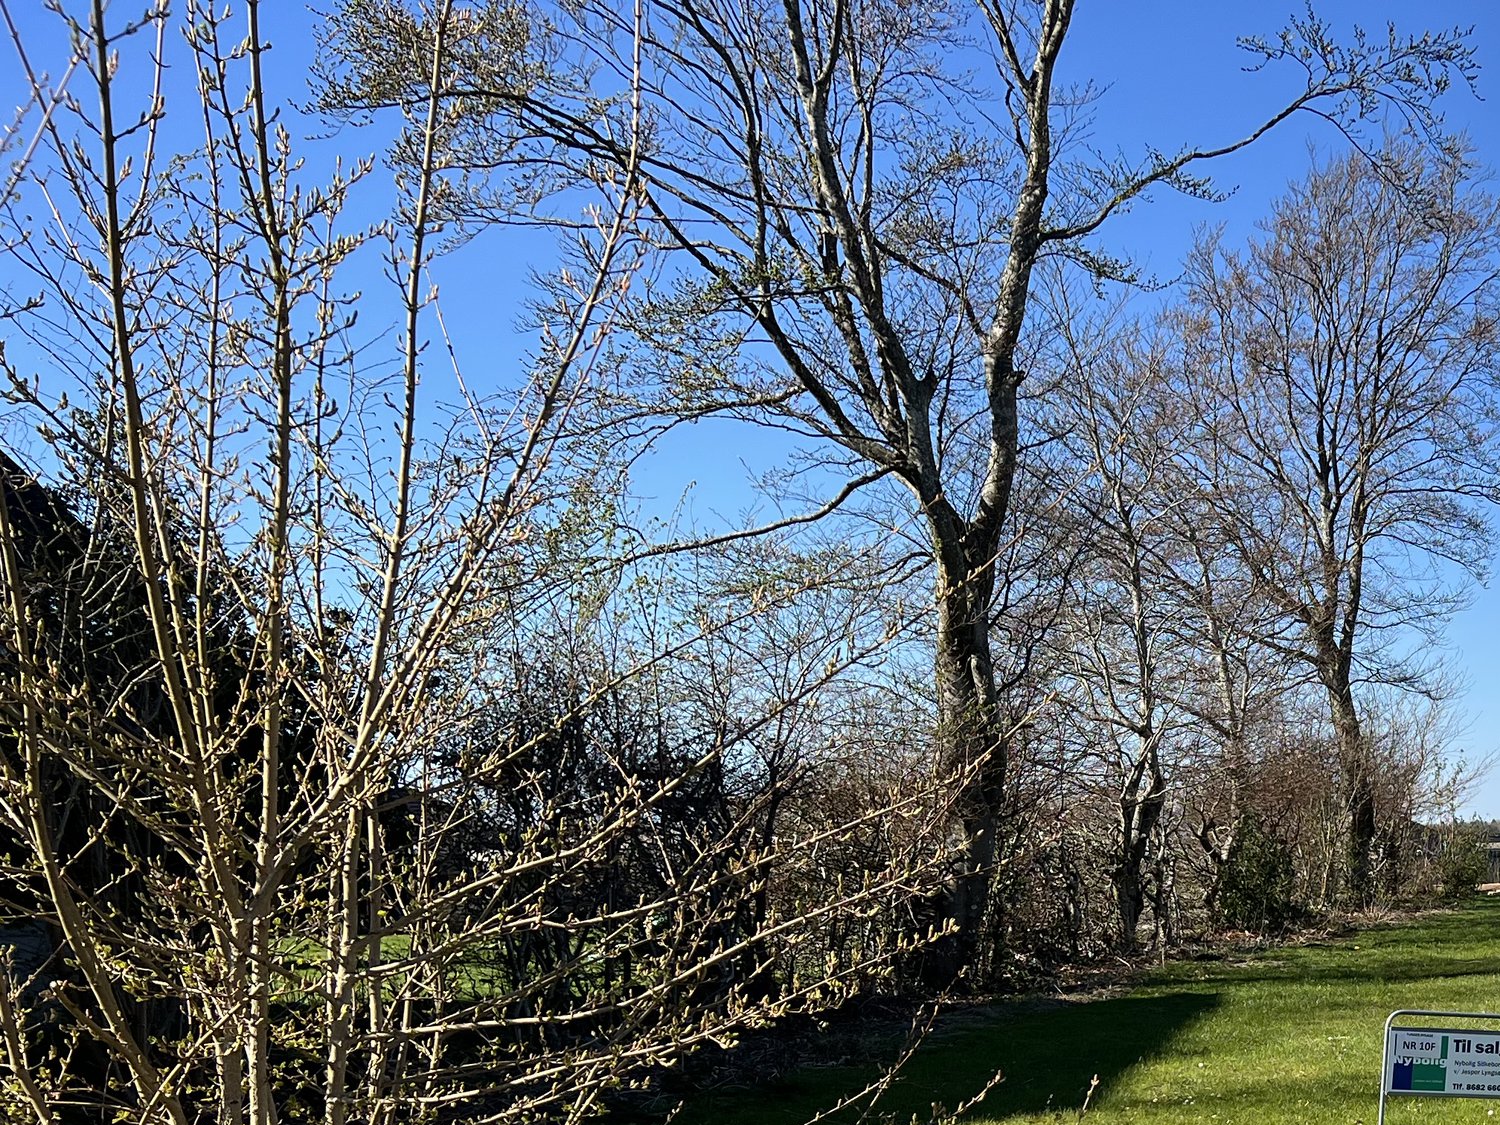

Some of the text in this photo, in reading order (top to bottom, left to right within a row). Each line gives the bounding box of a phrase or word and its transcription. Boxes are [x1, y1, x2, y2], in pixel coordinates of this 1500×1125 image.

[1402, 1040, 1436, 1051] NR 10F
[1453, 1039, 1471, 1053] Til
[1454, 1060, 1476, 1068] Nybolig
[1461, 1069, 1480, 1077] Jesper
[1452, 1083, 1464, 1091] Tlf.
[1466, 1083, 1486, 1092] 8682
